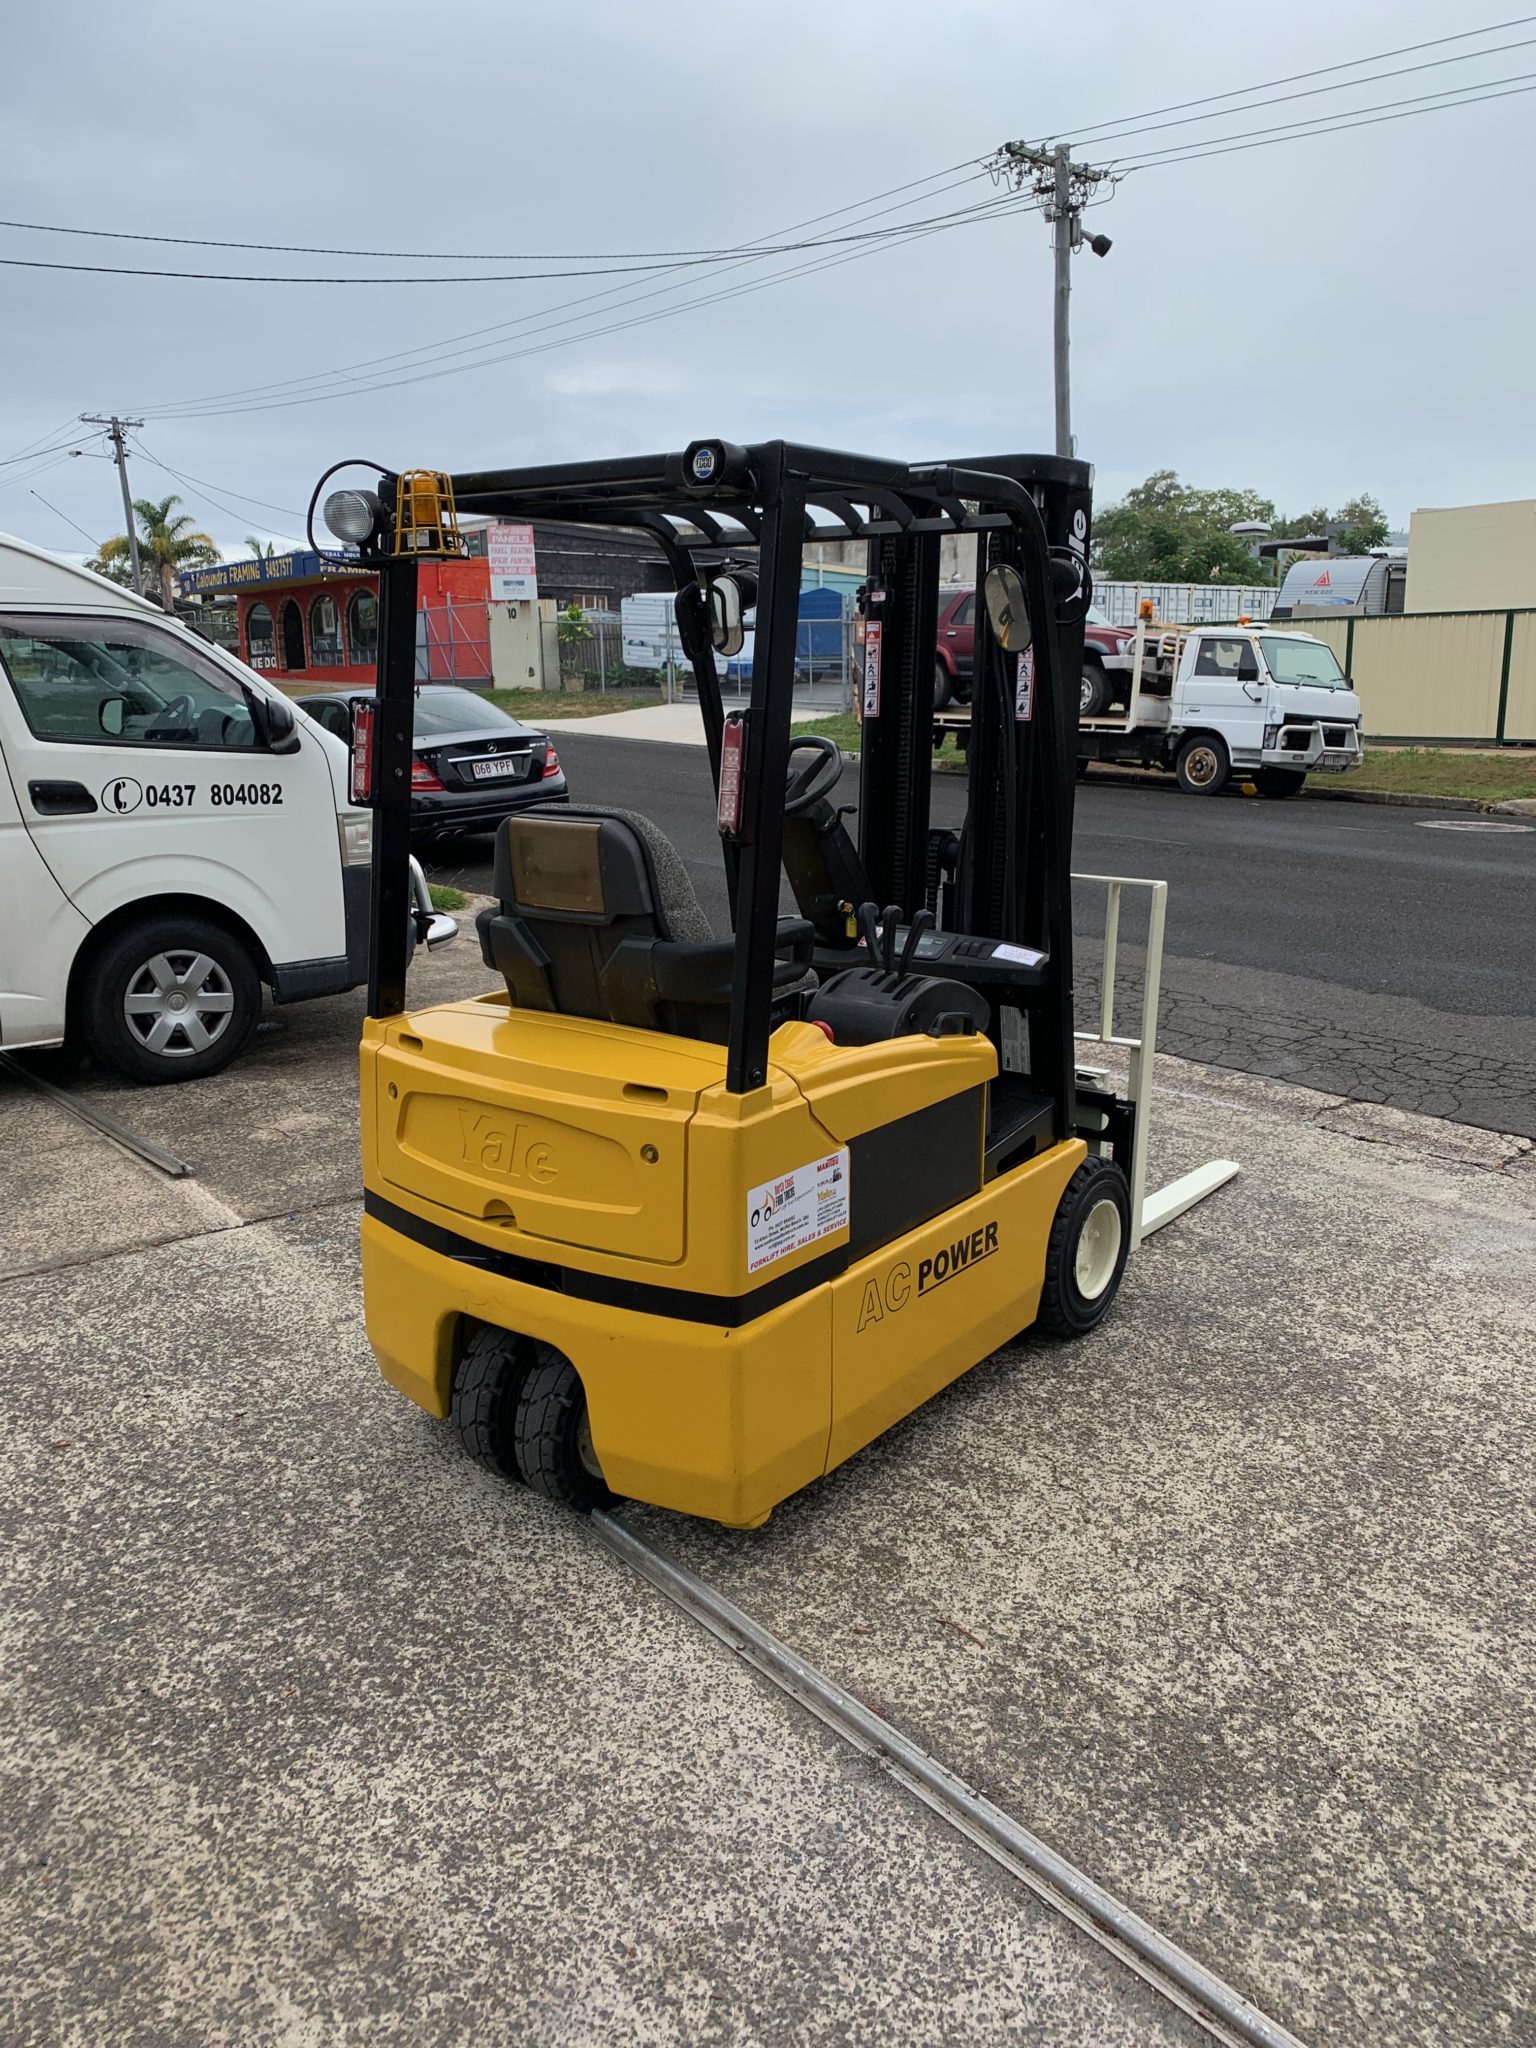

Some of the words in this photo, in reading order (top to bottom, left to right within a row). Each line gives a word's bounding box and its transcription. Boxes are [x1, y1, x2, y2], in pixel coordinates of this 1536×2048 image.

[492, 535, 530, 544] PANELS
[229, 562, 260, 583] FRAMING
[508, 607, 517, 620] 10
[251, 657, 263, 669] WE
[264, 656, 277, 668] DO
[493, 760, 511, 773] YPF
[146, 785, 196, 807] 0437
[211, 783, 283, 806] 804082
[458, 1107, 560, 1185] Yale
[750, 1250, 780, 1271] FORKLIFT
[797, 1232, 816, 1246] SALES
[823, 1217, 847, 1234] SERVICE
[857, 1262, 911, 1334] AC
[918, 1220, 999, 1292] POWER
